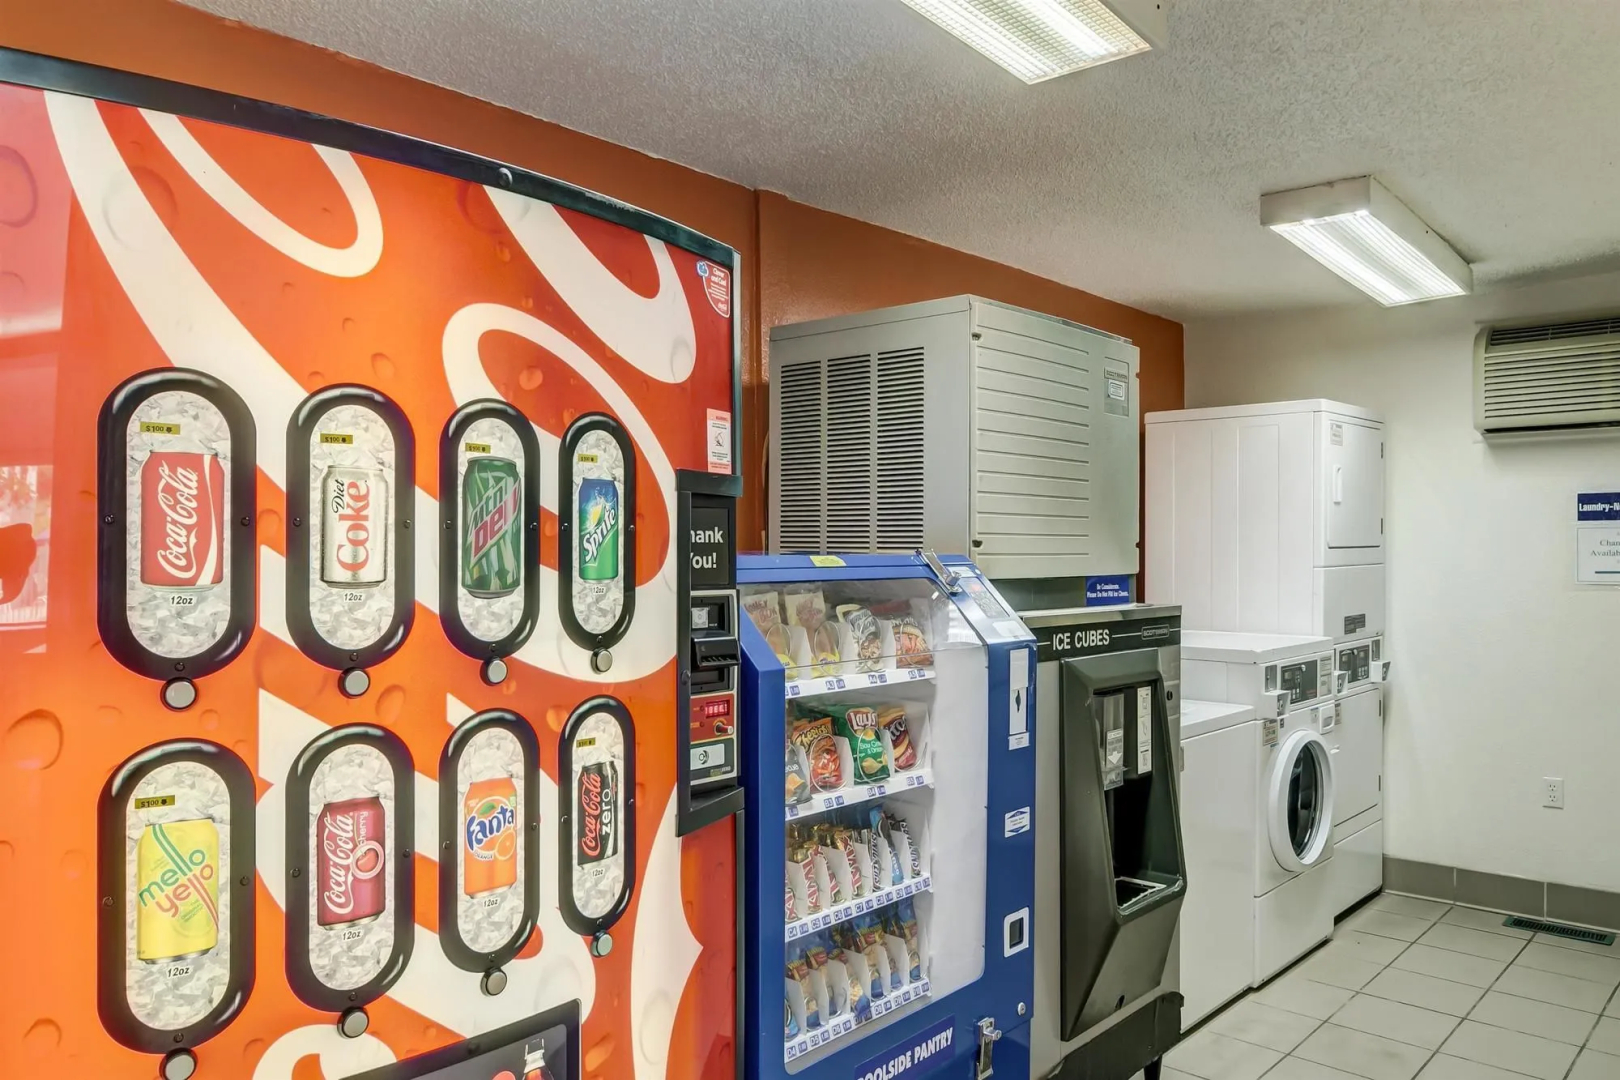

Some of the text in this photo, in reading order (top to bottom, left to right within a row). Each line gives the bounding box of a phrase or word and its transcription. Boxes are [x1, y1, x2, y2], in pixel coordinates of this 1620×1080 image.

[331, 479, 345, 514] Diet
[336, 480, 370, 572] Coke
[583, 506, 615, 563] Sprite
[170, 594, 194, 606] 12oz
[343, 592, 363, 602] 12oz
[1052, 629, 1110, 650] ICE CUBES
[602, 788, 611, 836] zero
[138, 824, 206, 907] mello
[155, 863, 218, 932] yello
[483, 898, 499, 908] 12oz
[343, 930, 362, 940] 12oz
[167, 966, 190, 978] 12oz
[858, 1027, 953, 1080] OLSIDE PANTRY
